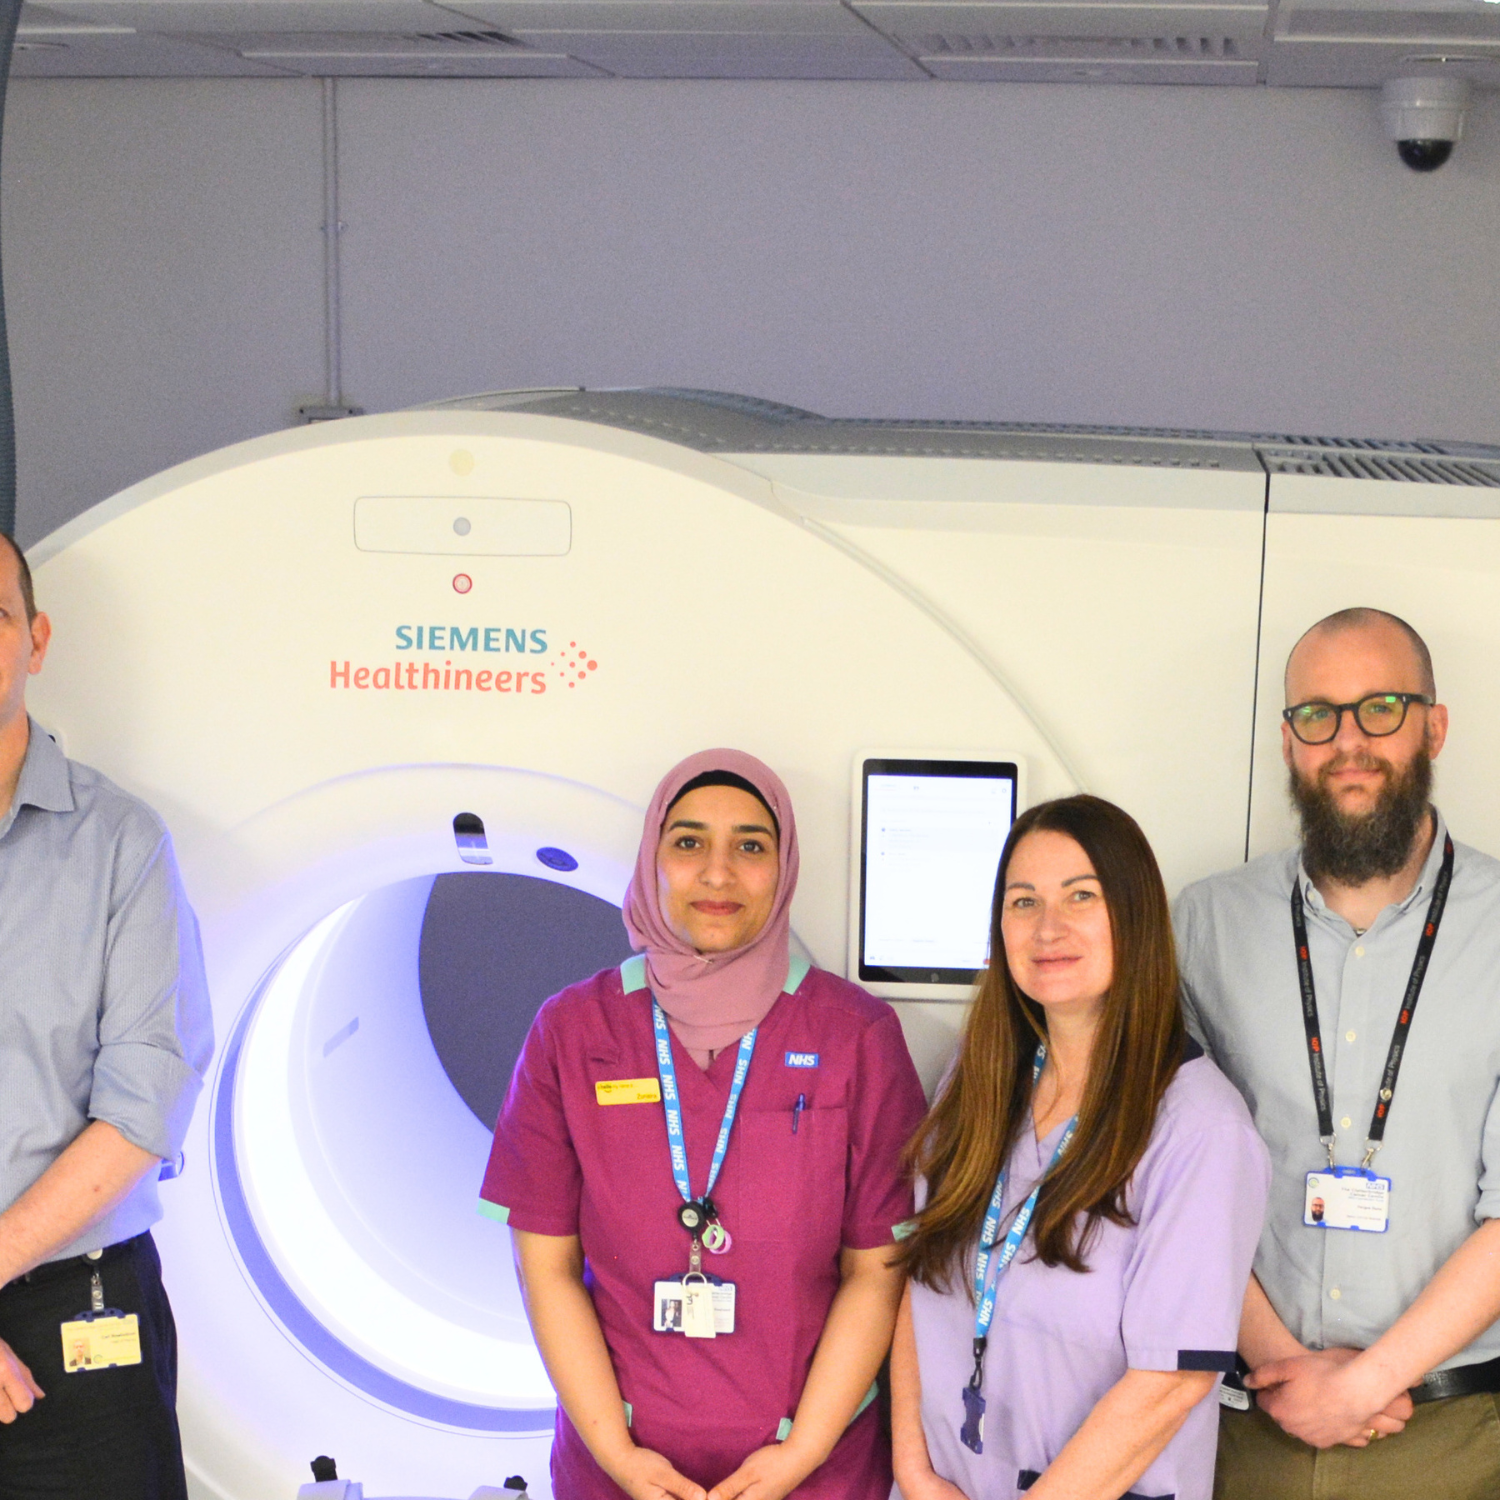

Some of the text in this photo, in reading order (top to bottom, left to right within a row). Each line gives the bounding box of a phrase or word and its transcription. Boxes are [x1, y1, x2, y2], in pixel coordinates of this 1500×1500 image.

[395, 625, 548, 654] SIEMENS
[330, 660, 547, 694] Healthineers
[658, 1039, 671, 1065] NHS
[788, 1054, 816, 1066] NHS
[734, 1059, 748, 1085] NHS
[663, 1074, 676, 1100] NHS
[667, 1109, 680, 1136] NHS
[716, 1128, 728, 1153] NHS
[672, 1145, 685, 1171] NHS
[982, 1216, 997, 1245] NHS
[1011, 1207, 1030, 1236] NHS
[975, 1252, 988, 1280] NHS
[978, 1298, 993, 1326] NHS
